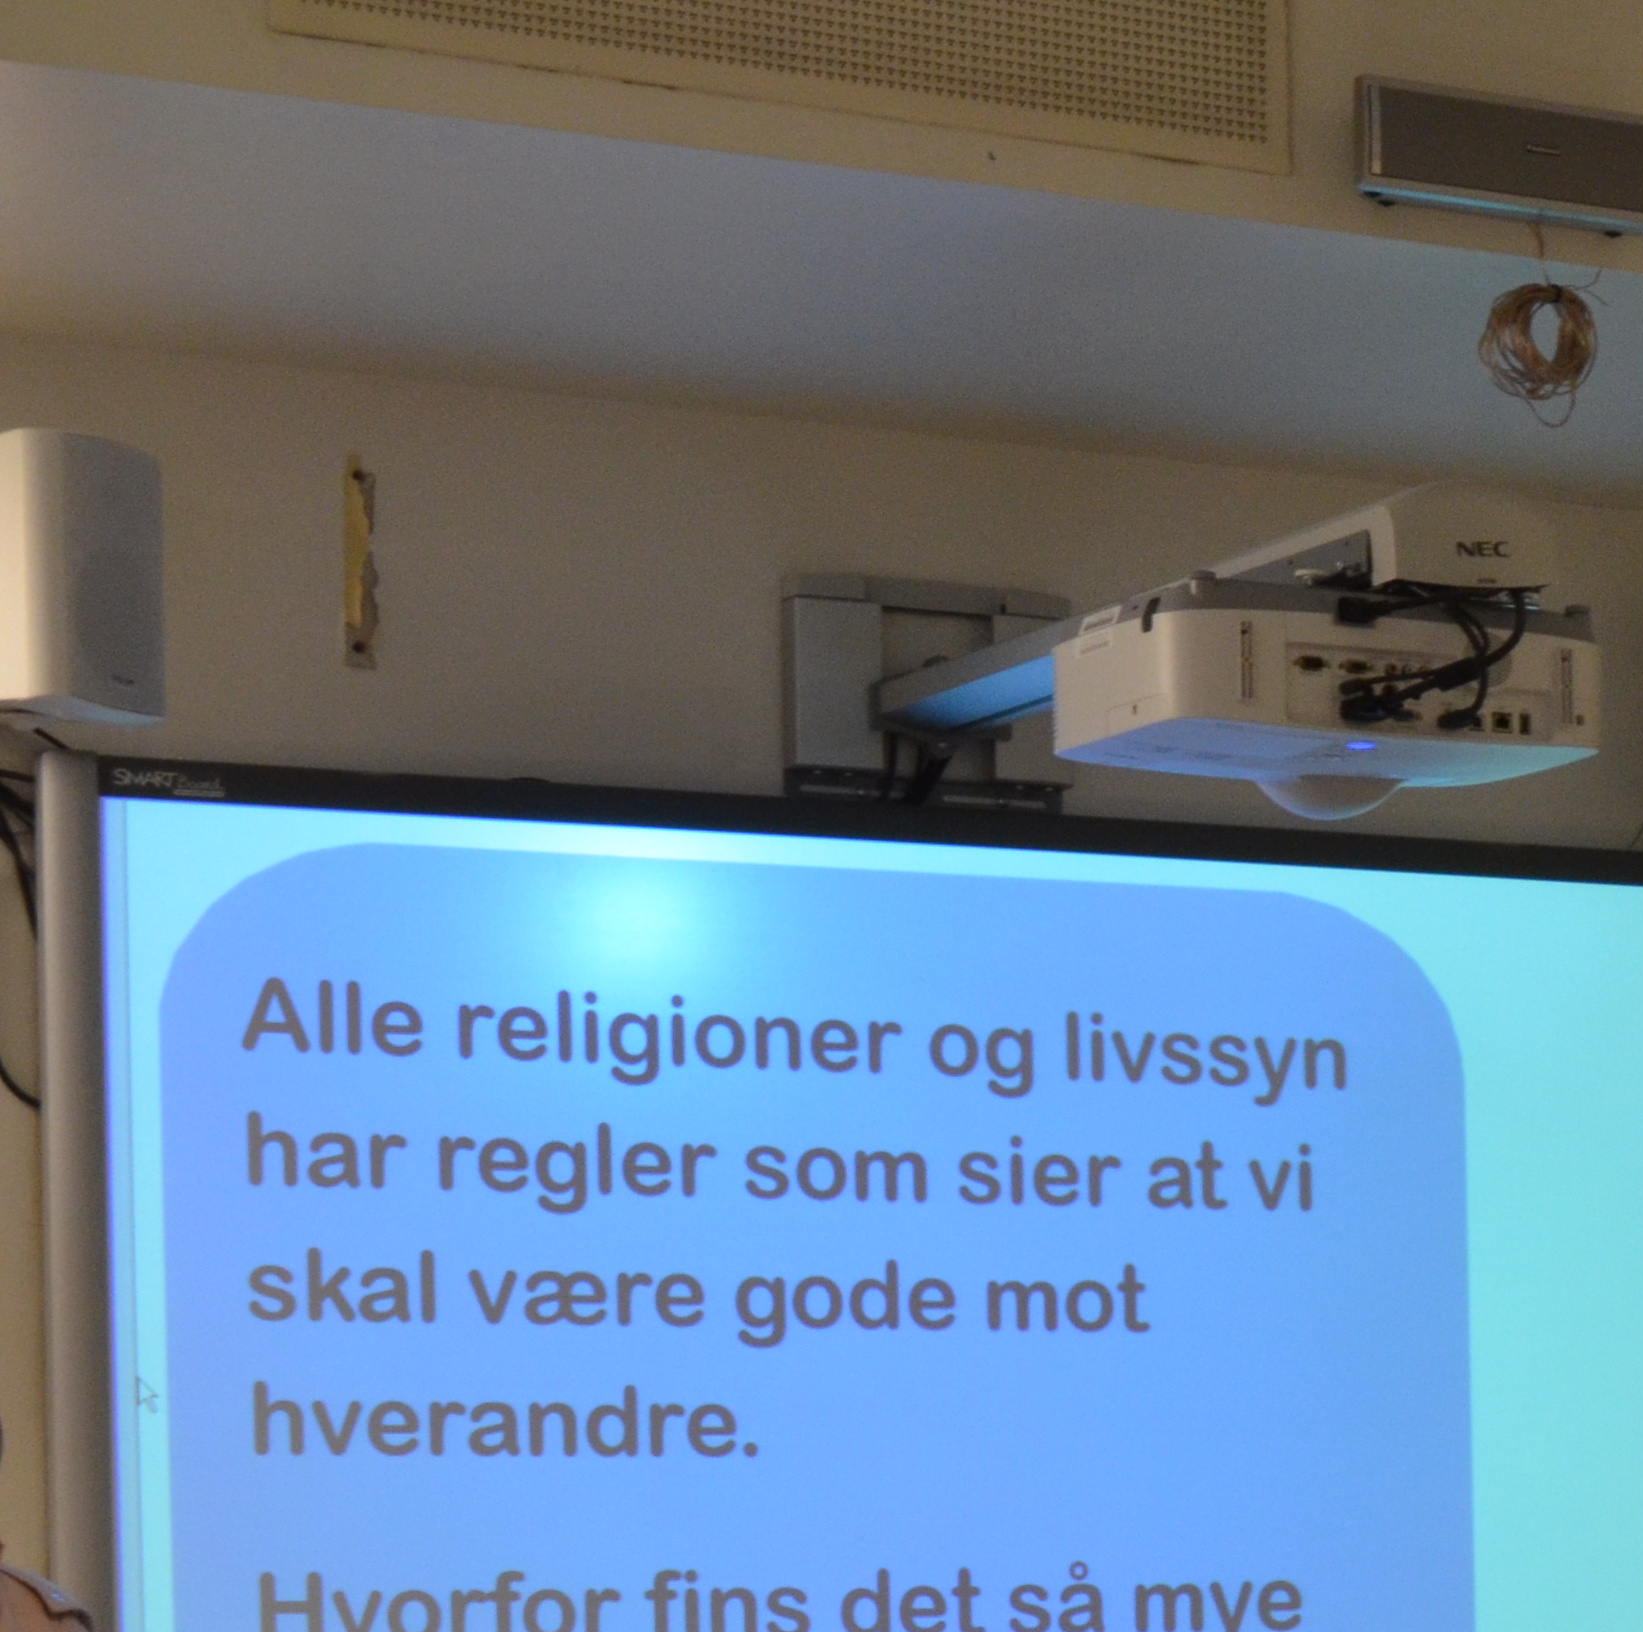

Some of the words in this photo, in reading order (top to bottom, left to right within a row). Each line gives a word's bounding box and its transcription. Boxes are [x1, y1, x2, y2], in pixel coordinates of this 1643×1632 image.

[1456, 541, 1509, 557] NEC
[243, 979, 420, 1054] Alle
[461, 995, 899, 1083] religioner
[932, 1026, 1031, 1096] og
[1068, 1012, 1345, 1105] livssyn
[248, 1112, 405, 1187] har
[441, 1124, 714, 1212] regler
[748, 1147, 925, 1200] som
[961, 1137, 1119, 1204] sier
[1150, 1143, 1225, 1208] at
[1251, 1145, 1310, 1209] vi
[249, 1248, 434, 1321] skal
[470, 1271, 702, 1325] være
[737, 1261, 954, 1346] gode
[989, 1264, 1148, 1331] mot
[253, 1382, 756, 1455] hverandre.
